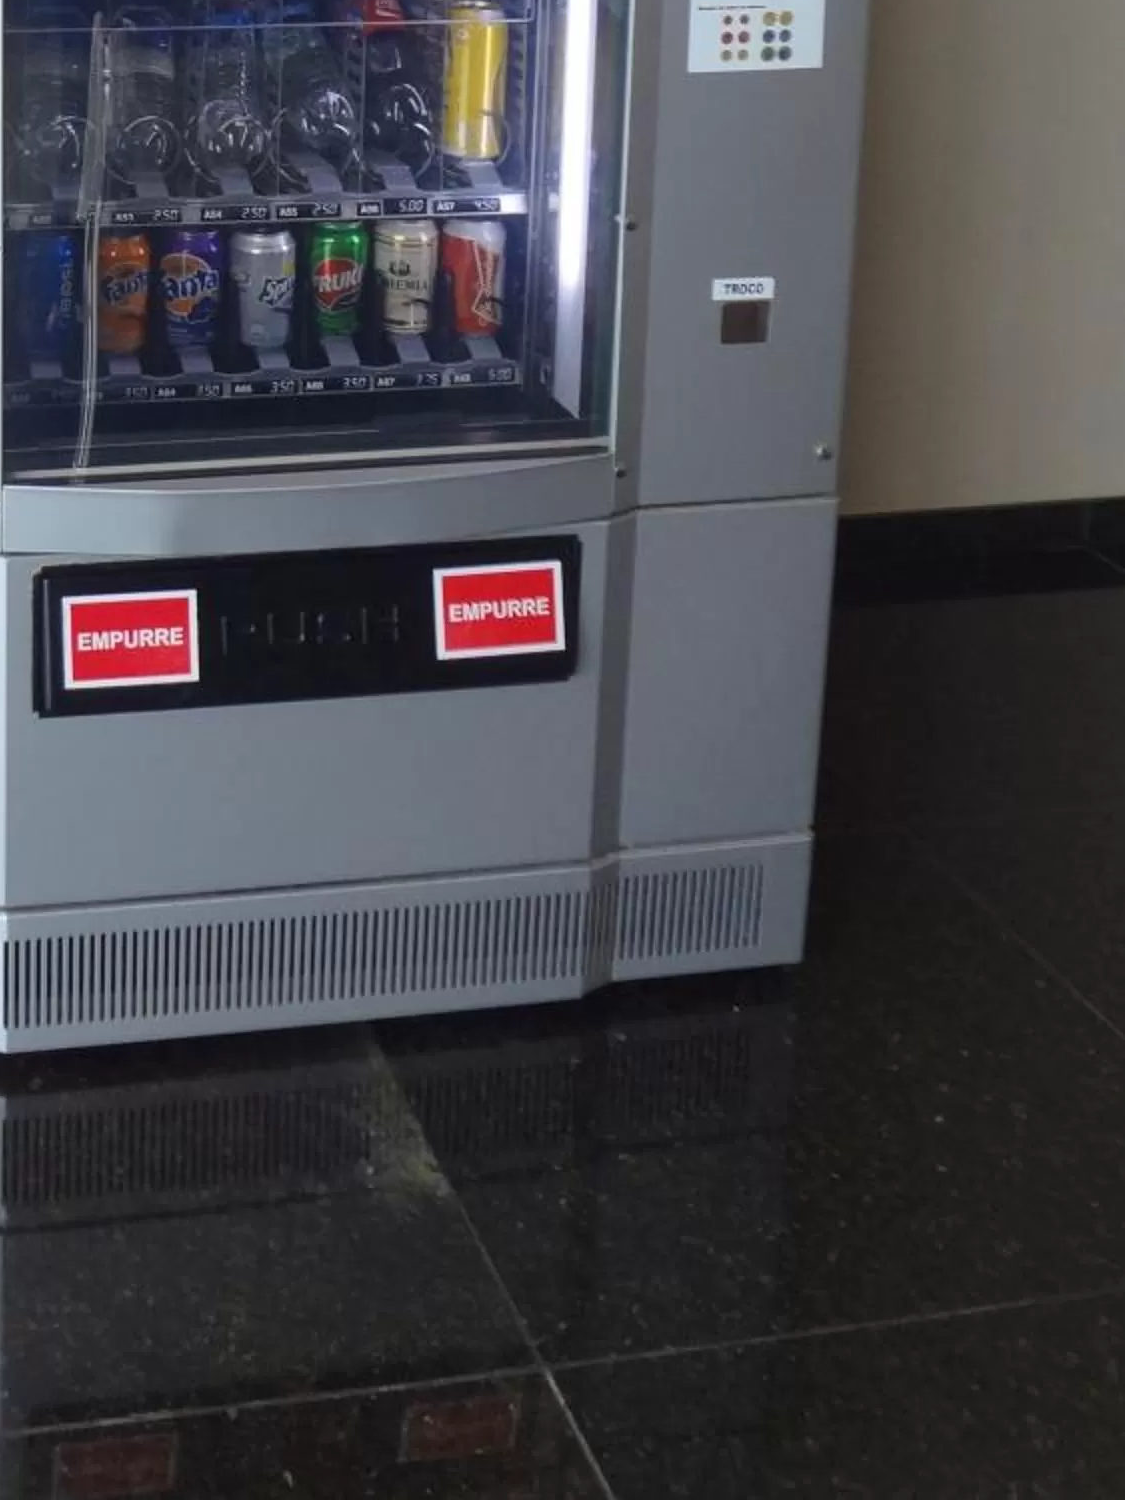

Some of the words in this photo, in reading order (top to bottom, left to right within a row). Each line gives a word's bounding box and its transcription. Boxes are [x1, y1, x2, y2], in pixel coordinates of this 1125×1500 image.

[723, 283, 764, 295] TROCO
[448, 596, 551, 623] EMPURRE
[77, 626, 184, 652] EMPURRE
